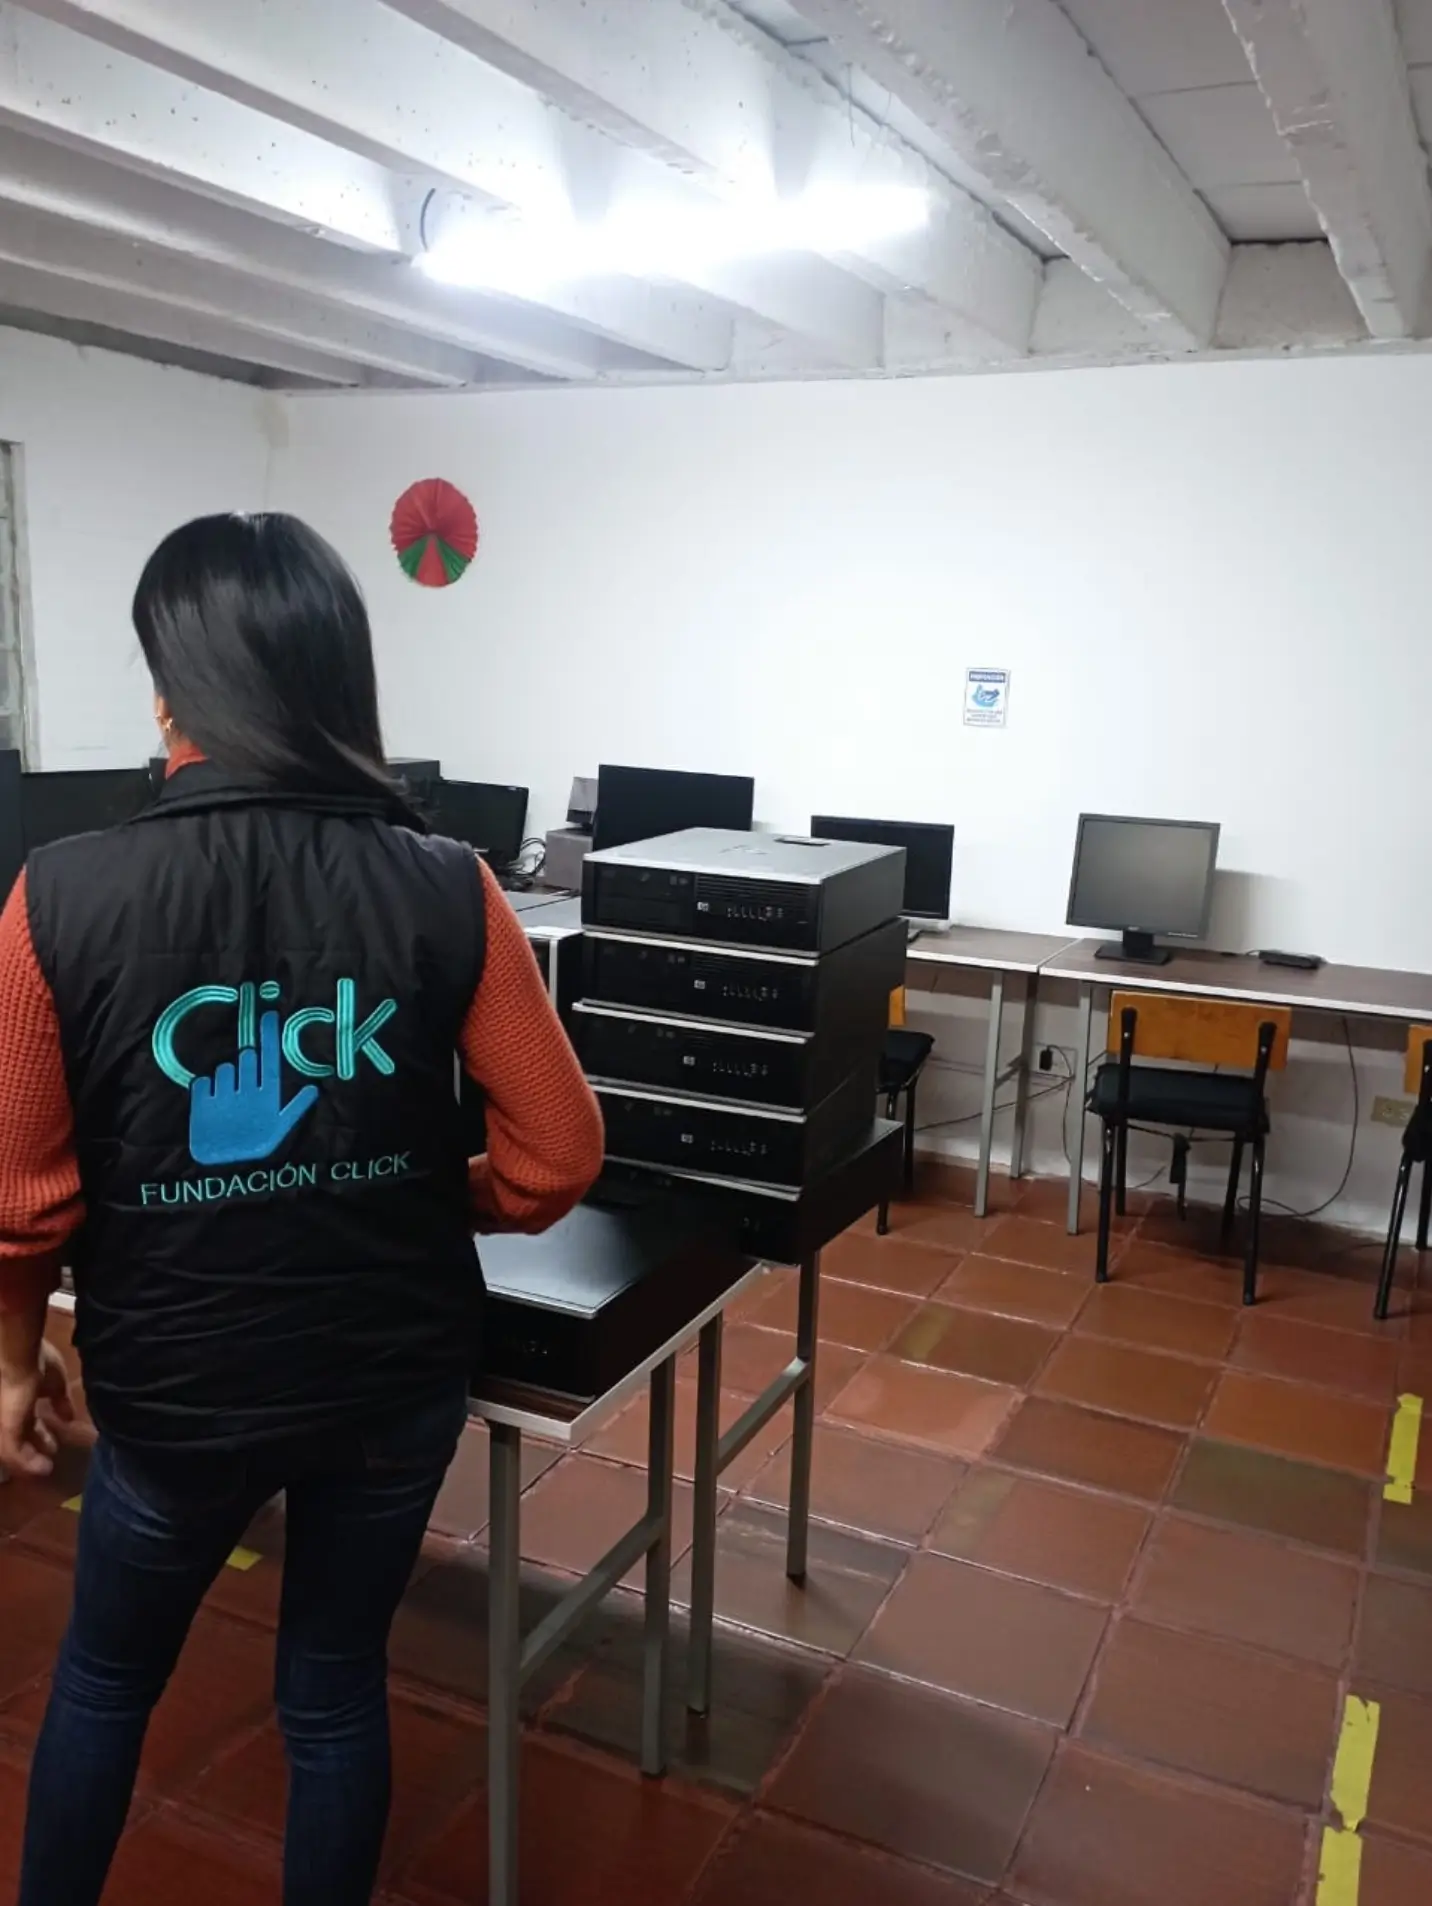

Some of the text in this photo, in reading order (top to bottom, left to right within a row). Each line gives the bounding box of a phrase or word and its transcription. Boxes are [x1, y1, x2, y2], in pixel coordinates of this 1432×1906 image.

[151, 977, 398, 1090] Click
[140, 1150, 411, 1205] FUNDACIÓN CLICK
